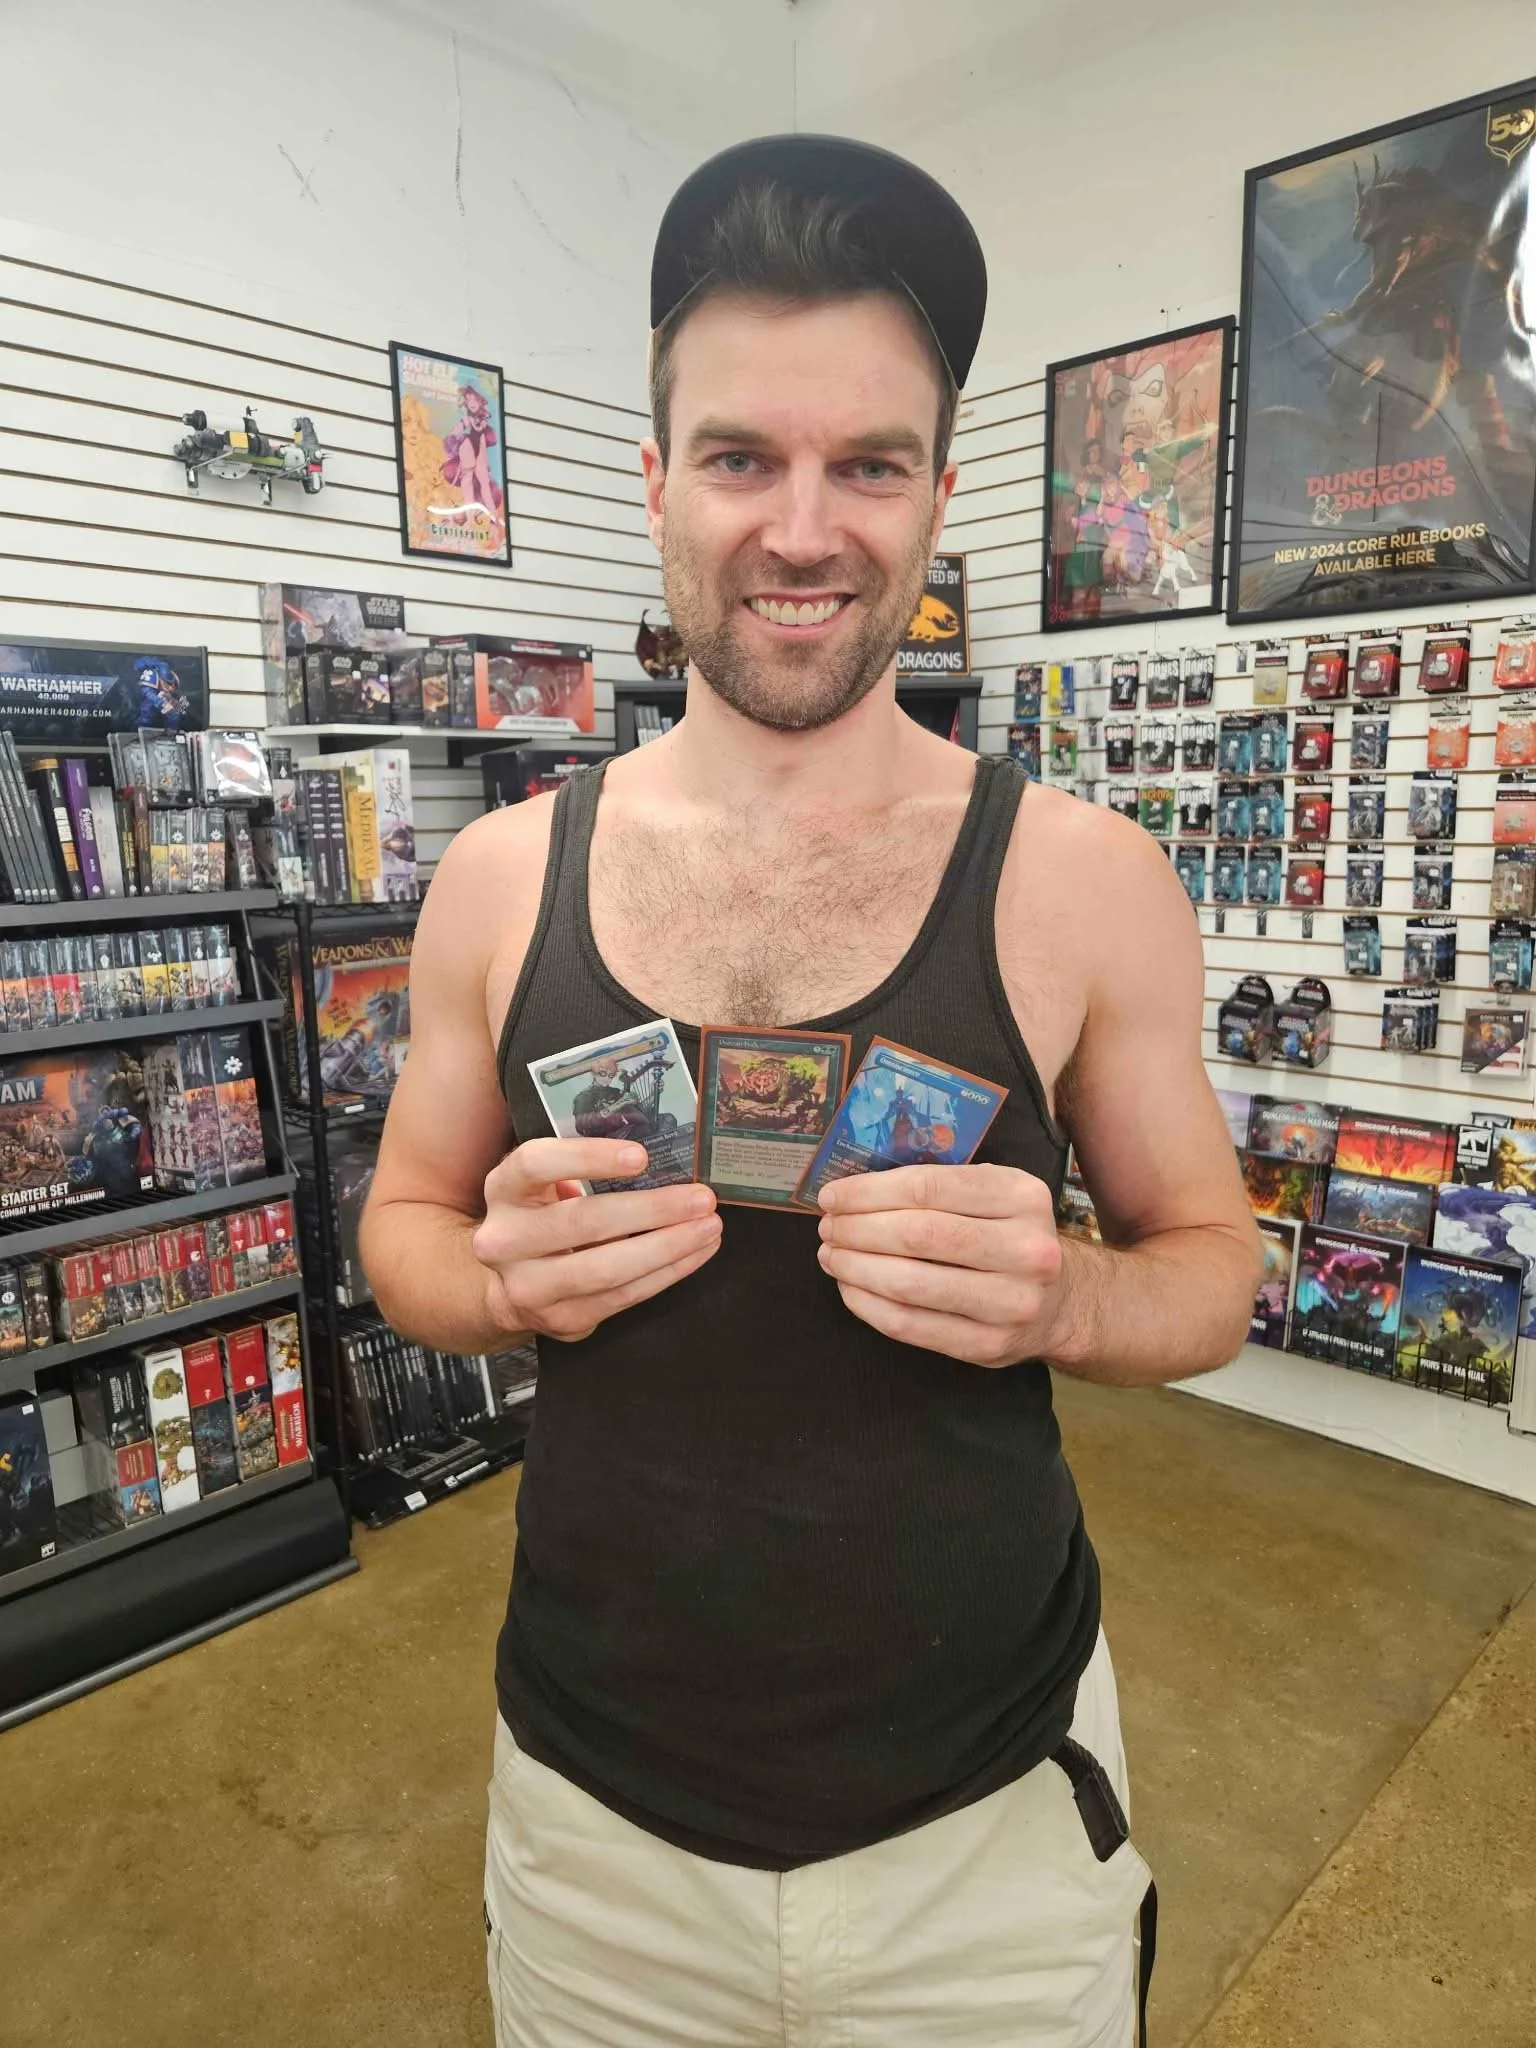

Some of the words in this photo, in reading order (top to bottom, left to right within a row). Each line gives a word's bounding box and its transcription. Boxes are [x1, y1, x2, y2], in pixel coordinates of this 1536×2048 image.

[1306, 456, 1448, 497] DUNGEONS
[1333, 476, 1456, 512] DRAGONS
[1274, 549, 1307, 565] NEW
[1310, 542, 1344, 559] 2024
[1347, 537, 1387, 555] CORE
[1390, 523, 1486, 548] RULEBOOKS
[930, 559, 948, 569] REA
[1314, 554, 1392, 576] AVAILABLE
[1396, 549, 1436, 565] HERE
[947, 570, 960, 584] BY
[896, 652, 963, 669] DRAGONS
[0, 677, 103, 695] WARHAMMER
[0, 706, 112, 718] ARHAMMER40000.COM
[359, 796, 375, 872] MEDIEVAL
[1, 1184, 47, 1207] STARTER
[49, 1181, 69, 1197] SET
[0, 1206, 27, 1219] COMBAT
[28, 1204, 36, 1214] IN
[38, 1200, 51, 1212] THE
[292, 1402, 303, 1448] WARRIOR
